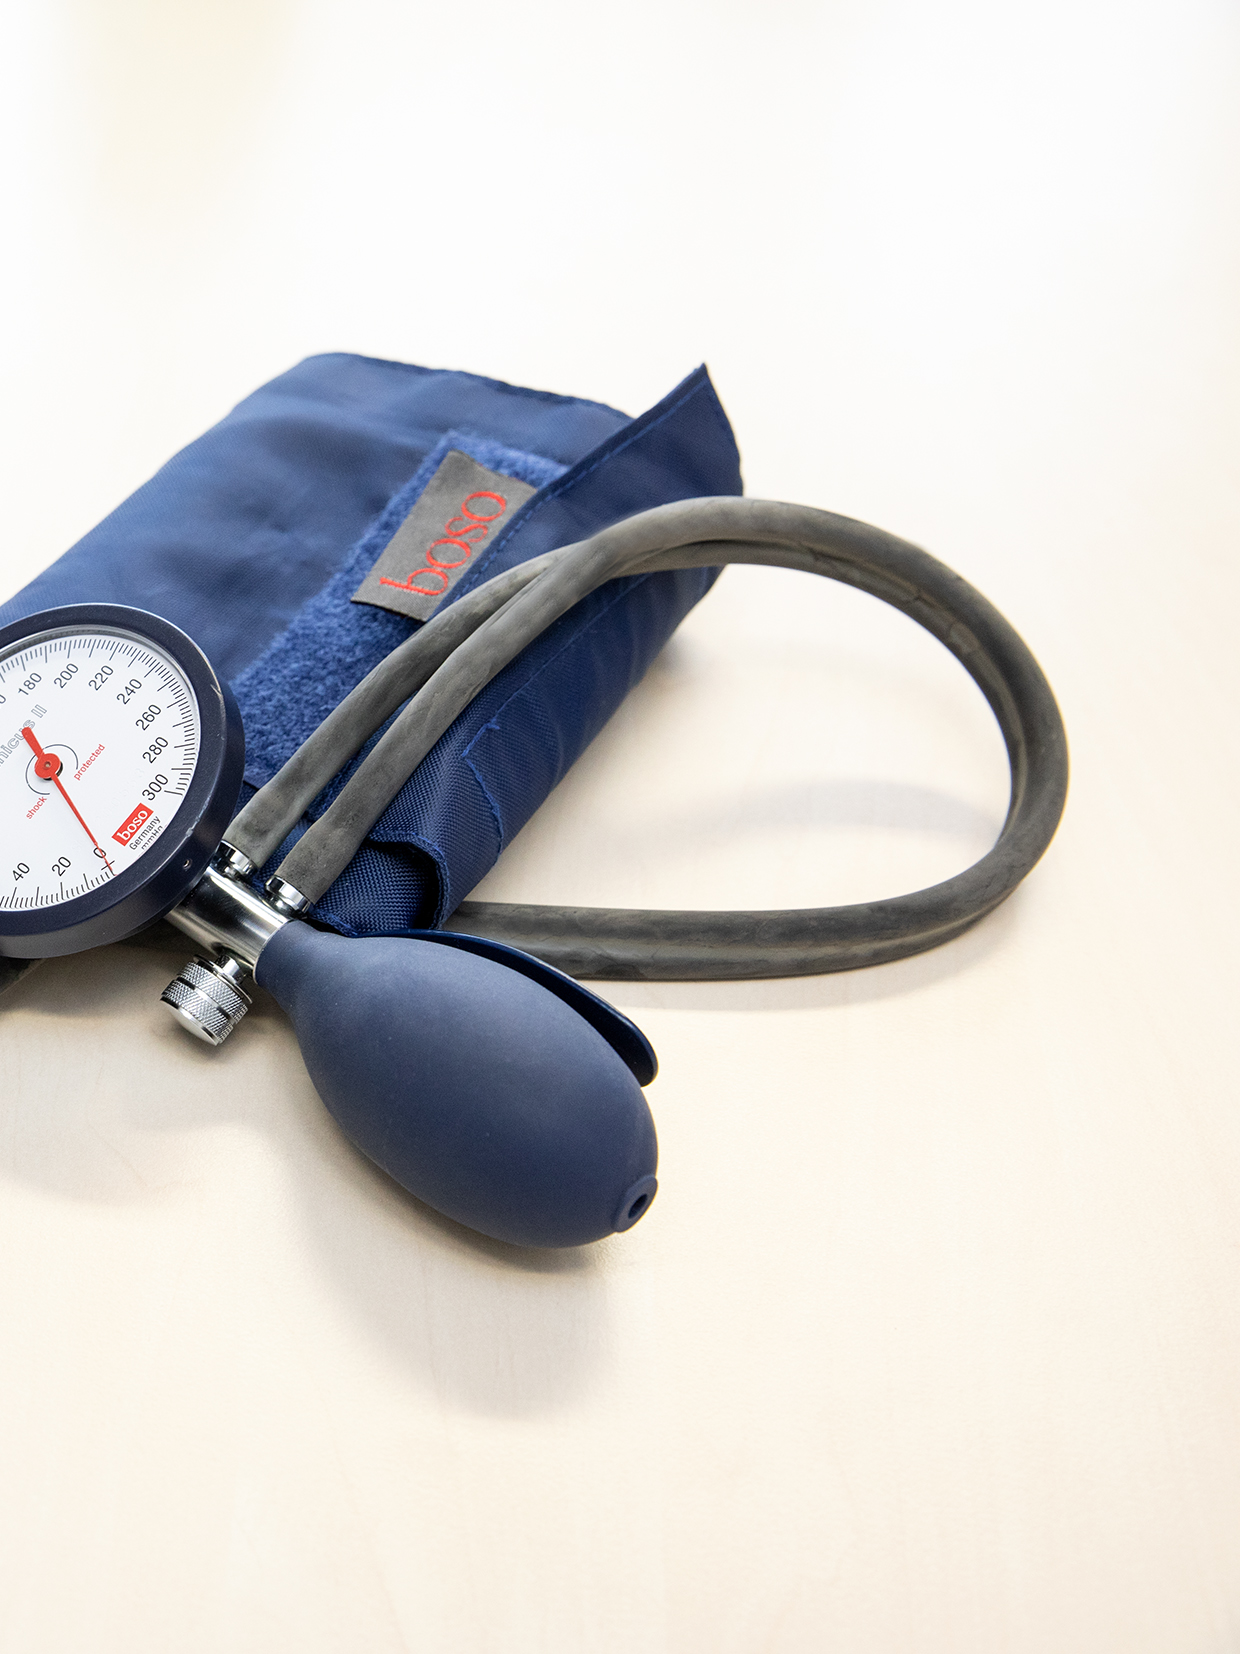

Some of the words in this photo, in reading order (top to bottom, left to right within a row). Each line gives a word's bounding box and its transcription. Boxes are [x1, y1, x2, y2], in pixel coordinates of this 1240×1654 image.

[379, 490, 507, 596] boso
[17, 672, 42, 697] 180
[53, 663, 79, 689] 200
[88, 665, 114, 691] 220
[116, 678, 143, 705] 240
[135, 703, 162, 731] 260
[73, 743, 105, 781] protected
[142, 736, 169, 764] 280
[141, 773, 169, 801] 300
[26, 796, 47, 820] shock
[116, 810, 148, 841] boso
[129, 816, 161, 851] Germany
[51, 856, 72, 877] 20
[93, 847, 107, 859] 0
[12, 862, 31, 882] 40
